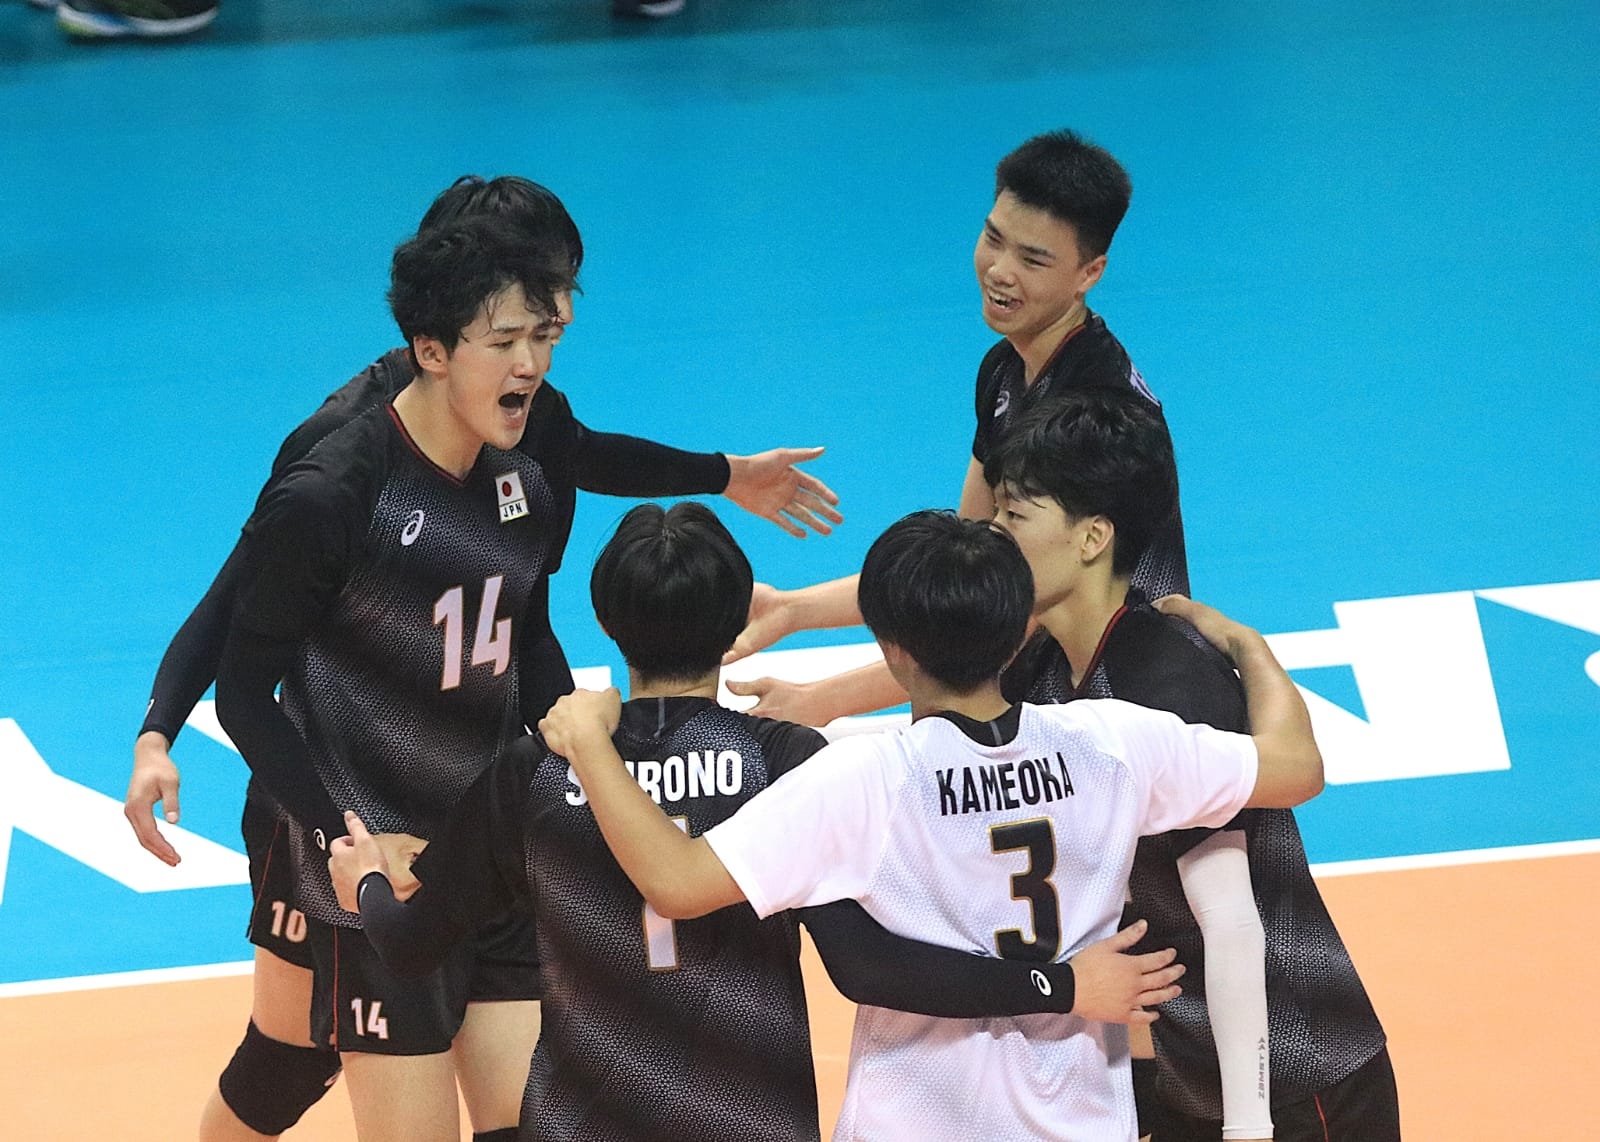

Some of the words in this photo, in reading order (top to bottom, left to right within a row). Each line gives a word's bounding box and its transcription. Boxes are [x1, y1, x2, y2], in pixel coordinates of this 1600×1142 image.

[502, 504, 524, 518] JPN
[432, 574, 513, 692] 14
[565, 749, 743, 807] SRONO
[935, 751, 1075, 816] KAMEOKA
[988, 815, 1062, 962] 3
[270, 899, 308, 943] 10
[350, 997, 390, 1040] 14
